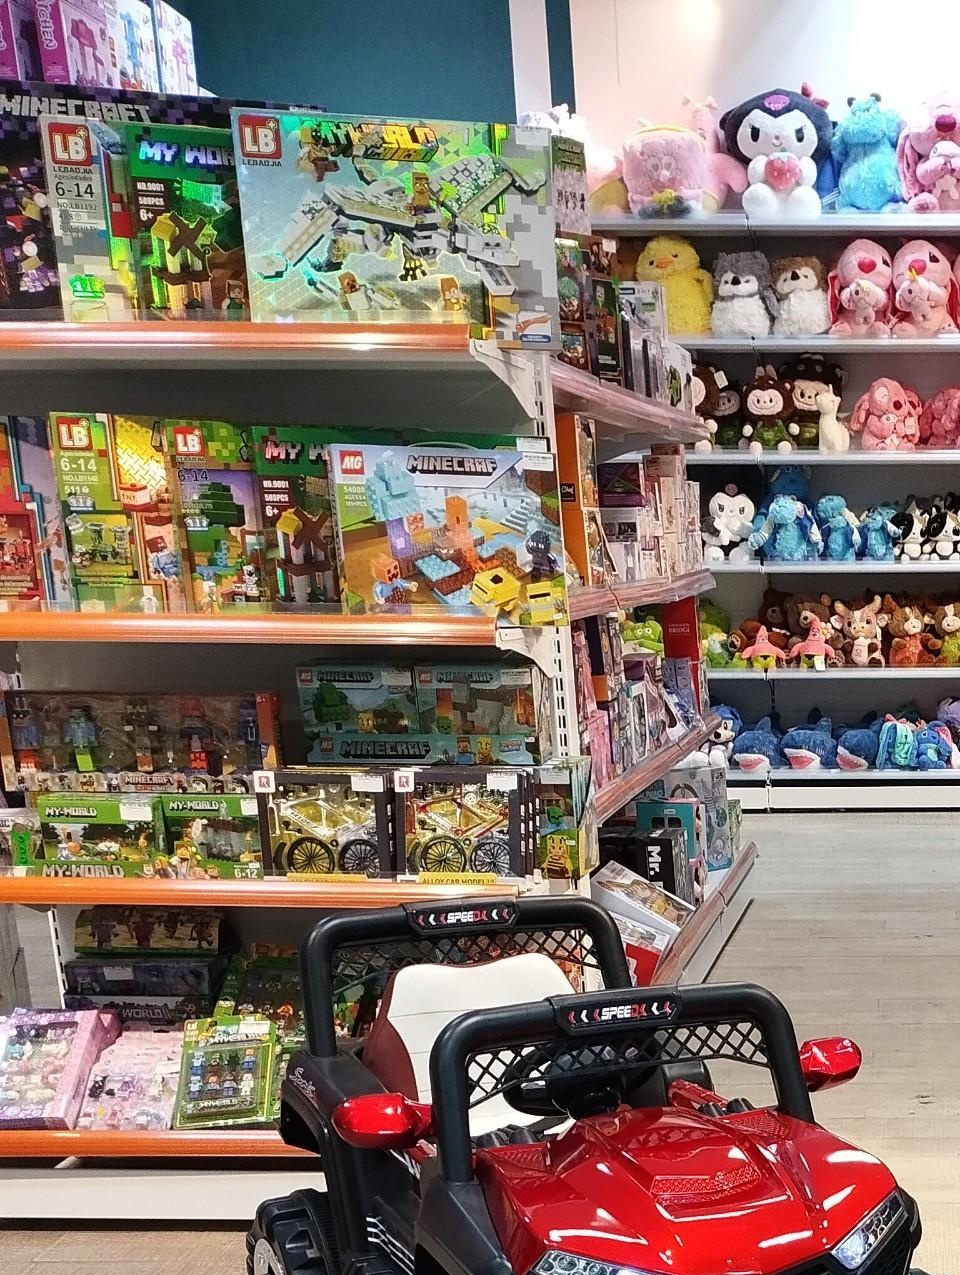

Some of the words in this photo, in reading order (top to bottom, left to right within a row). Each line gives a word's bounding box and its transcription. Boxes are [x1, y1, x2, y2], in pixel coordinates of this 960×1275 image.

[0, 94, 151, 123] MINECRAFT
[139, 140, 177, 162] MY
[56, 182, 95, 198] 6-14
[139, 210, 154, 221] 6+
[60, 458, 97, 472] 6-14
[406, 455, 498, 475] MINECRAF
[177, 469, 209, 482] 6-14
[265, 506, 279, 517] 6+
[647, 845, 662, 876] Mr.
[234, 868, 258, 879] 6-12
